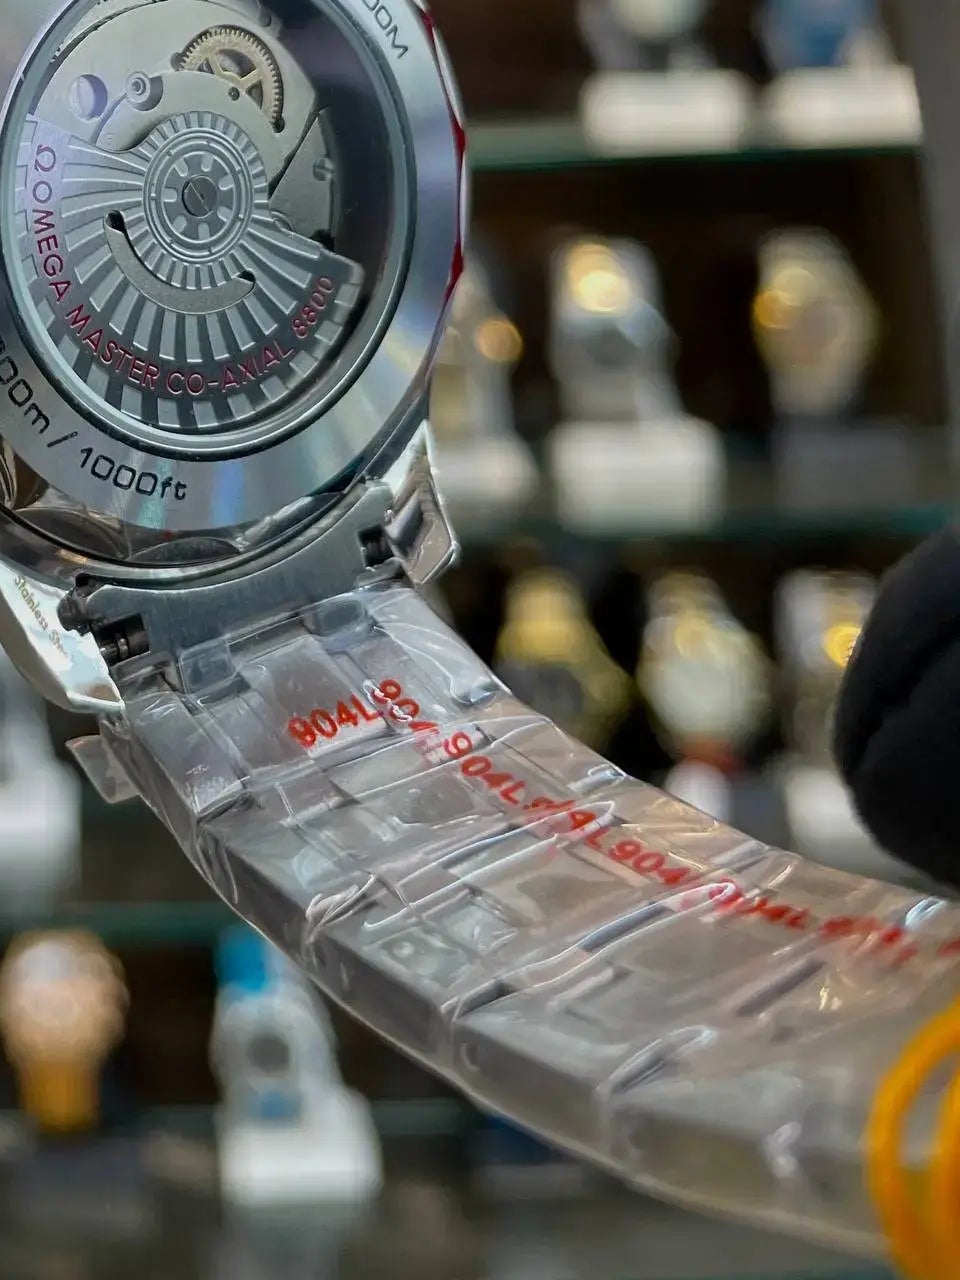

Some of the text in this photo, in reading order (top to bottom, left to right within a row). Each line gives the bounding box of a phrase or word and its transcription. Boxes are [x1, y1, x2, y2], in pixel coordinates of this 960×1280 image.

[32, 180, 73, 303] OMEGA
[64, 304, 161, 390] MASTER
[166, 340, 294, 395] CO-AXIAL
[292, 275, 335, 339] 8800
[79, 446, 188, 500] 1000ft
